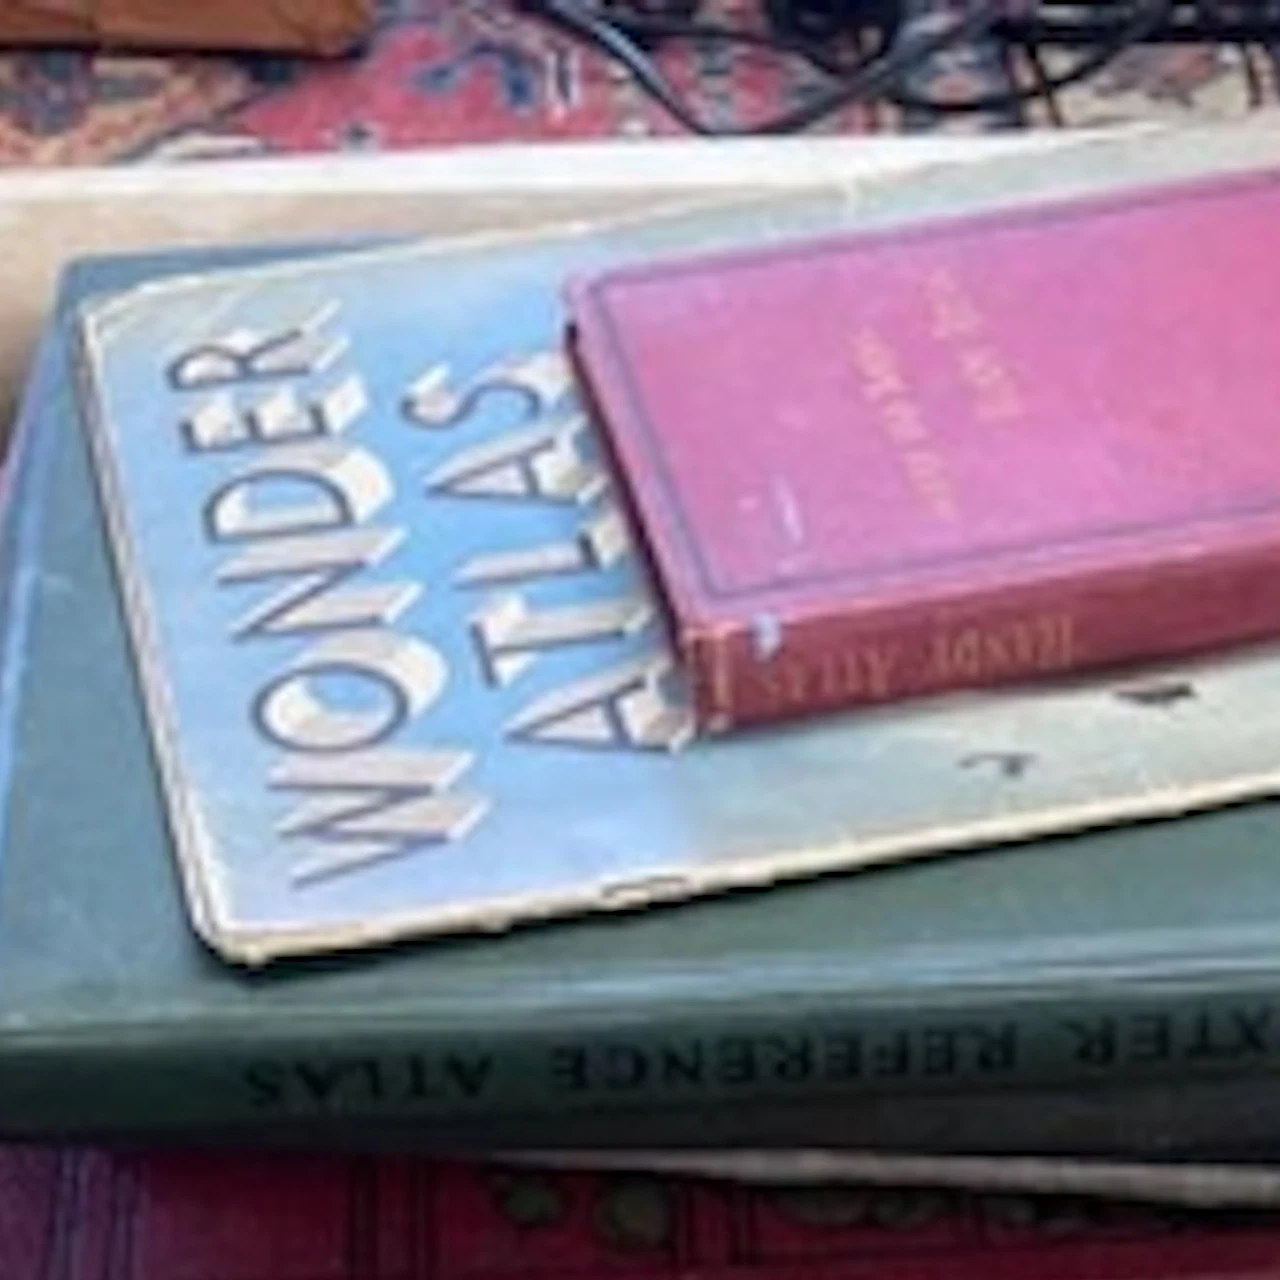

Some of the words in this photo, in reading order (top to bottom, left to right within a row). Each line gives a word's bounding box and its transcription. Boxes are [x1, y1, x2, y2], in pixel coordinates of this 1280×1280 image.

[168, 298, 490, 890] WONDER
[401, 350, 694, 752] ATLAS
[241, 1046, 495, 1106] ATLAS
[550, 1018, 1017, 1092] REFERENCE
